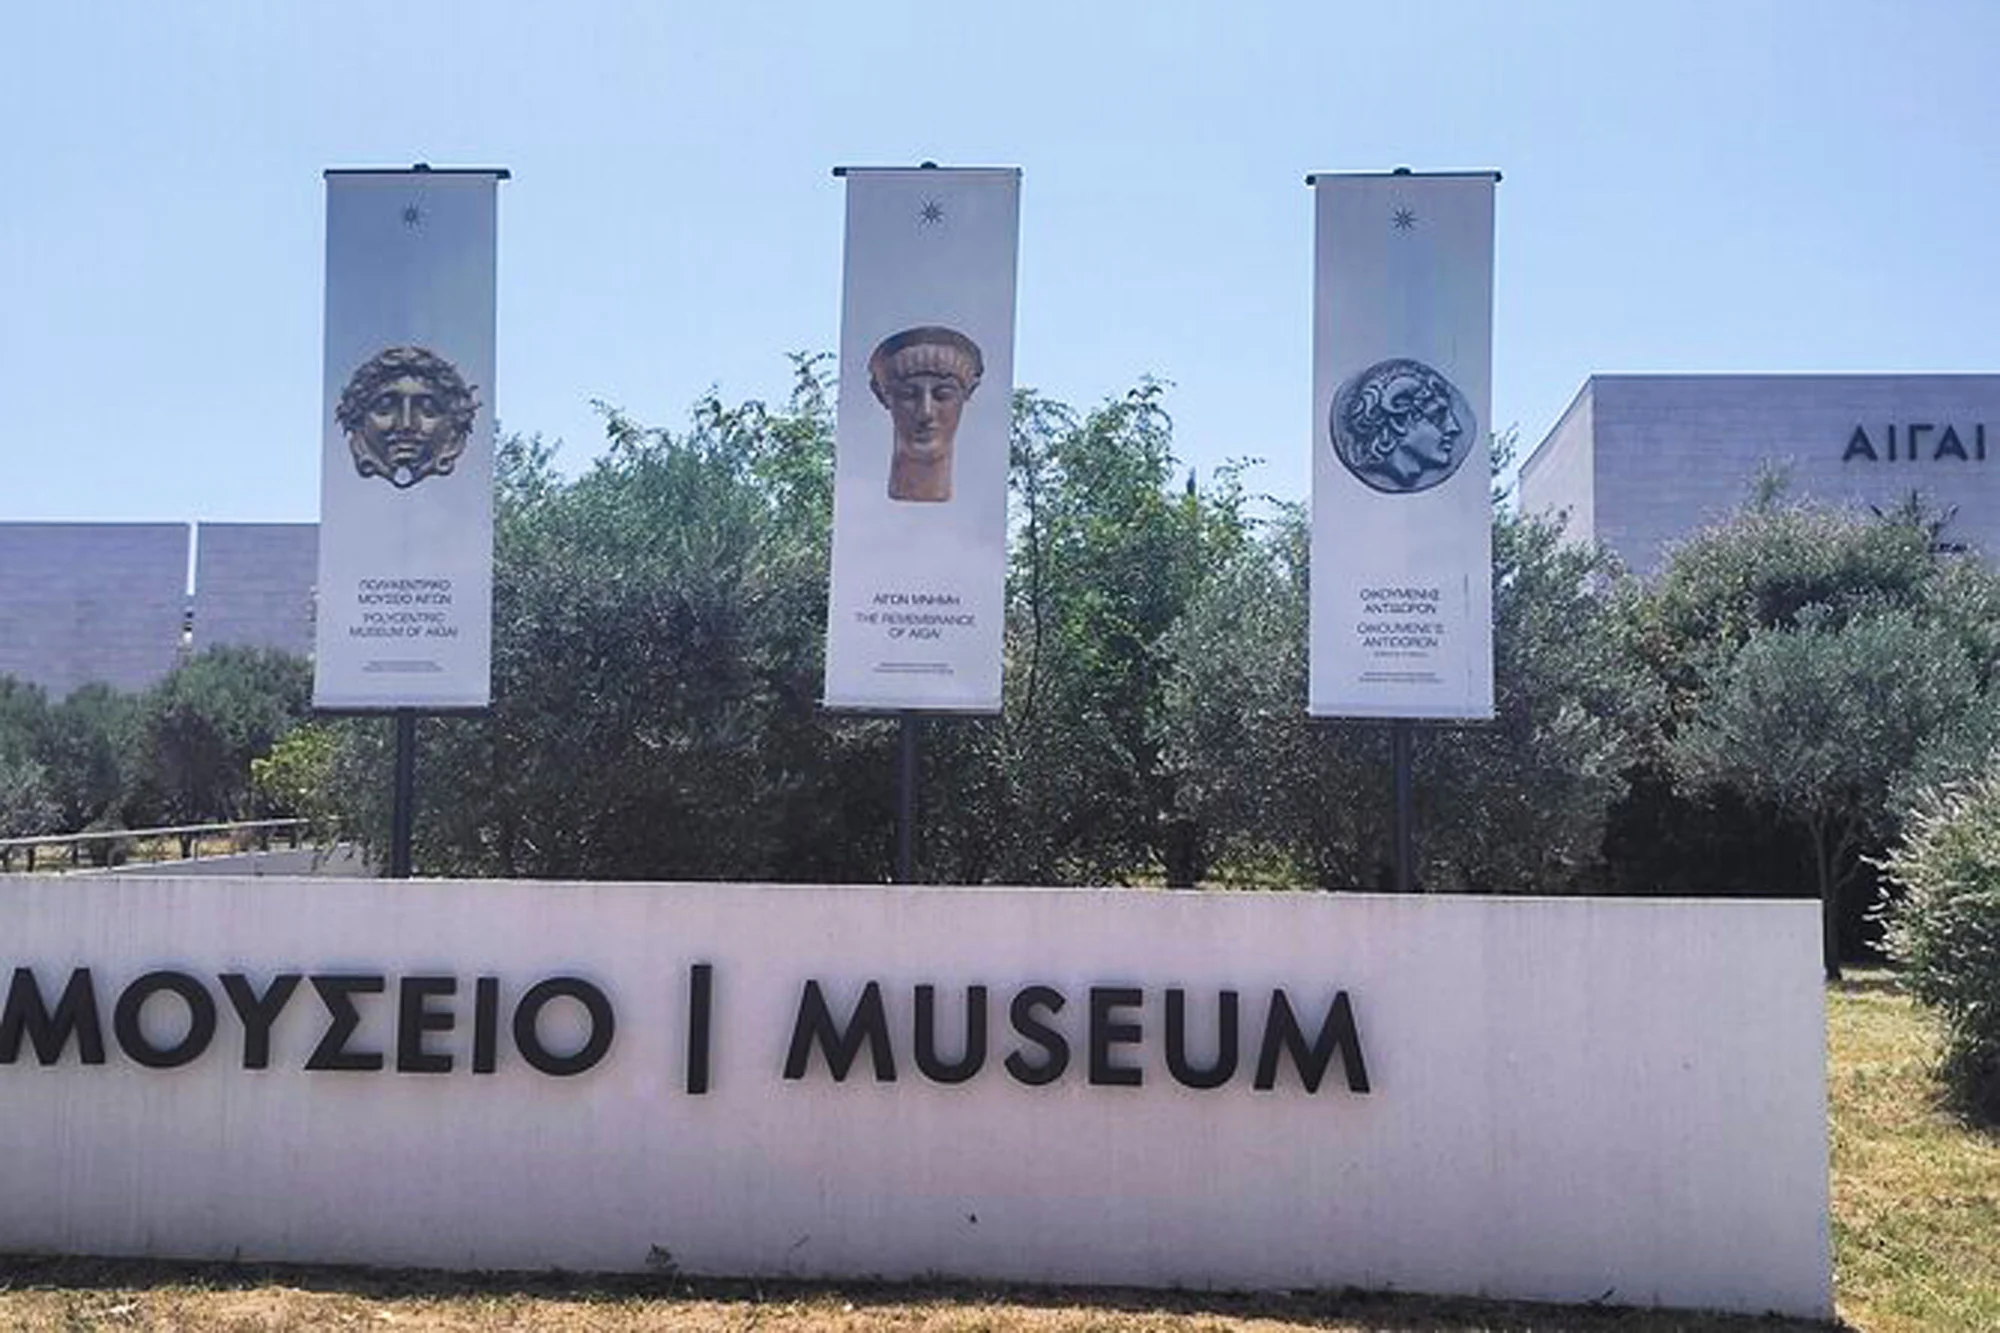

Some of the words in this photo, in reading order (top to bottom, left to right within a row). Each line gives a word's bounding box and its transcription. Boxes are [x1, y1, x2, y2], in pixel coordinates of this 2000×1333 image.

[1842, 424, 1986, 462] ΑΙΓΑΙ
[406, 626, 422, 638] OF
[888, 627, 905, 639] OF
[0, 967, 615, 1076] ΜΟΥΣΕΙΟ
[783, 979, 1371, 1094] MUSEUM
